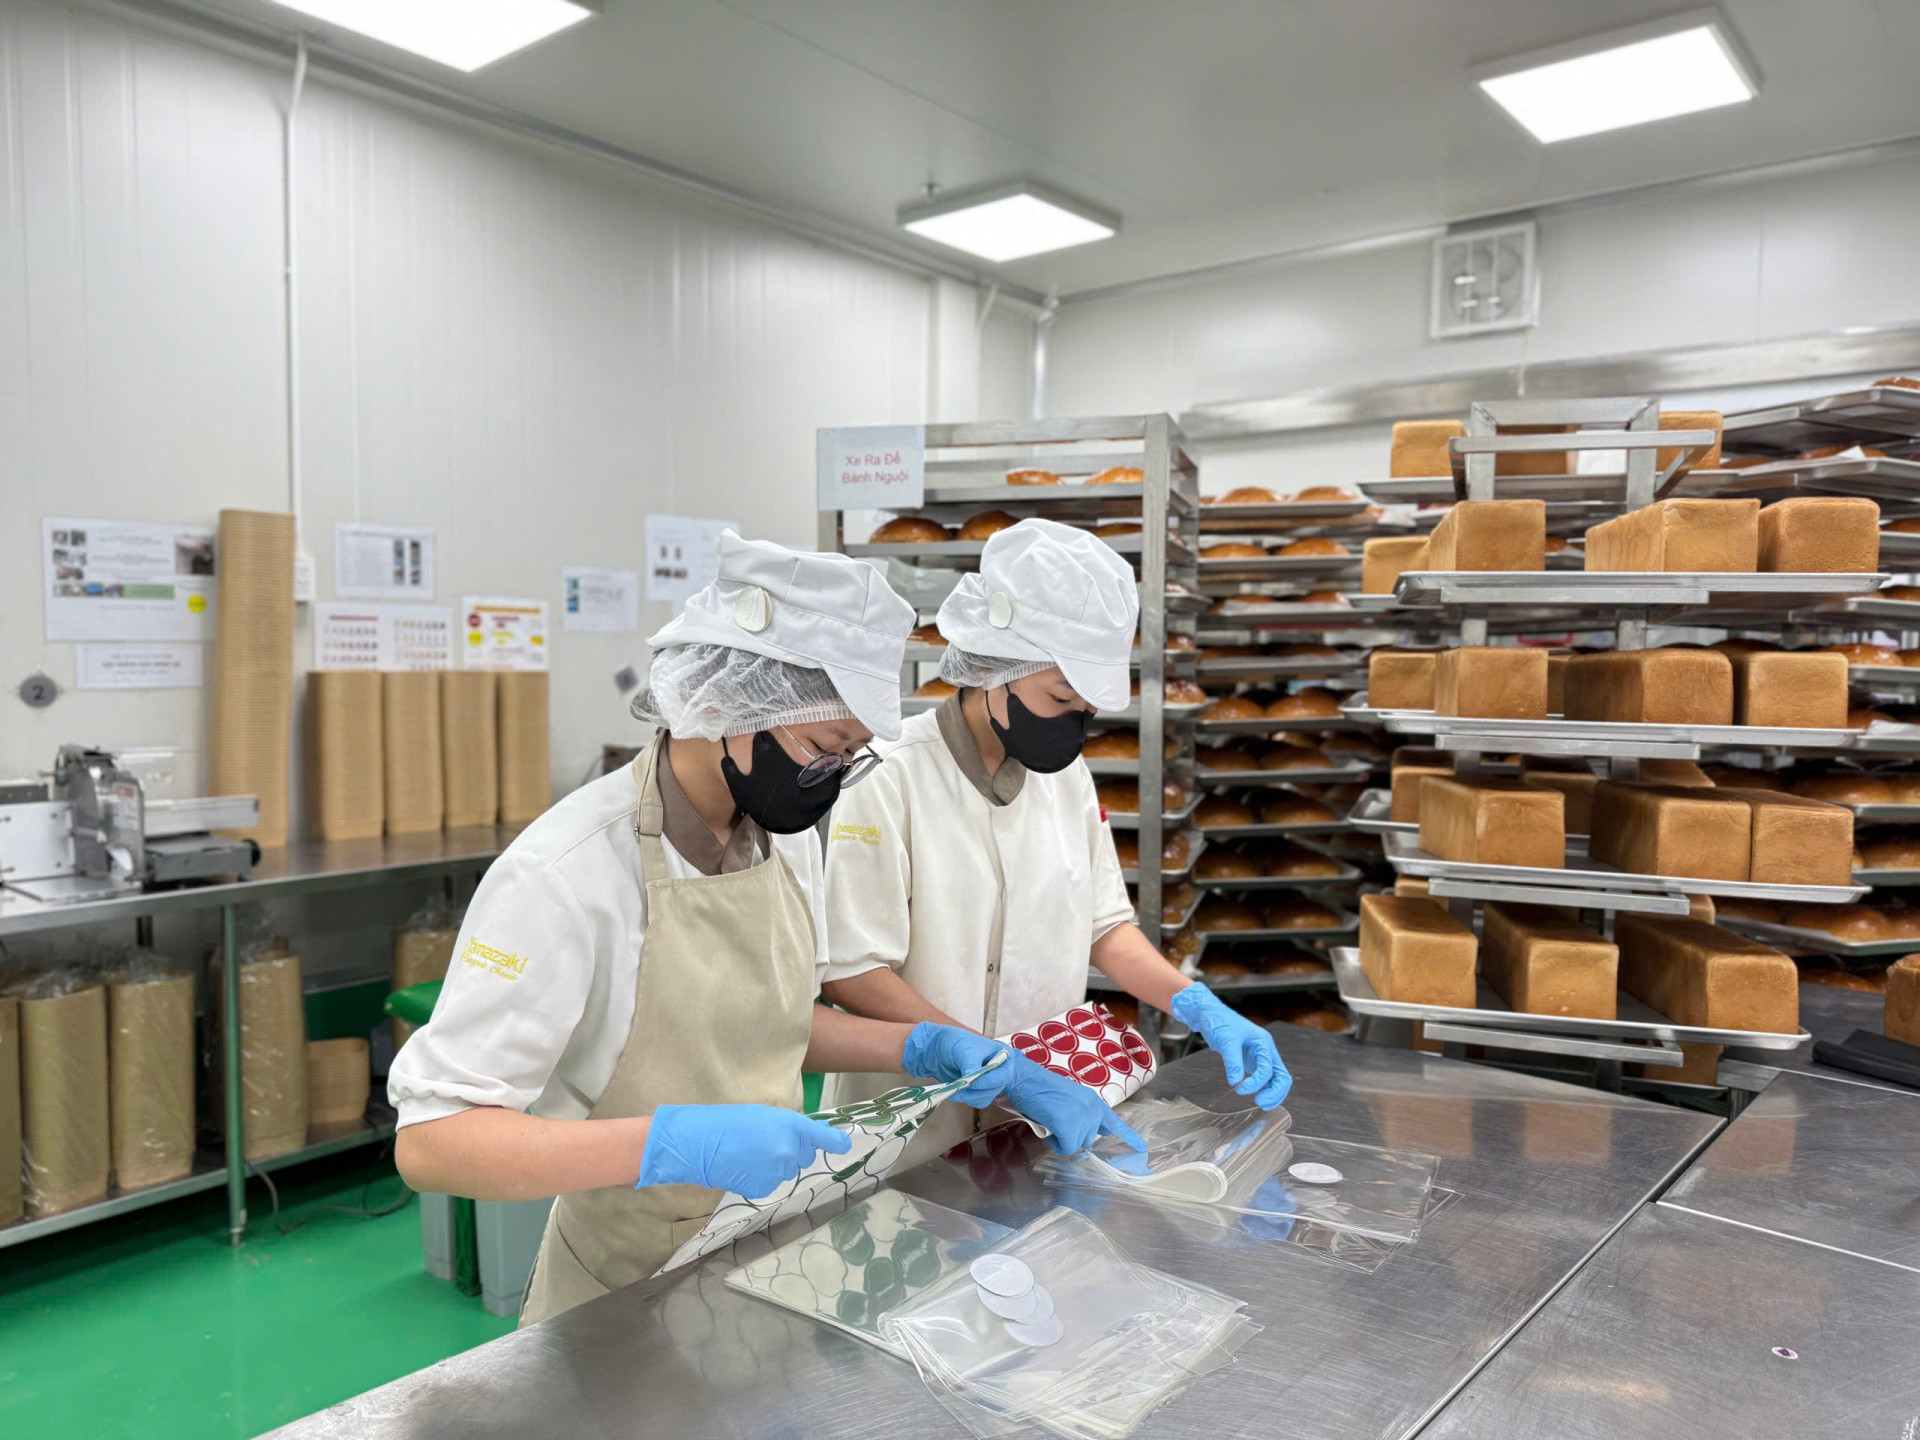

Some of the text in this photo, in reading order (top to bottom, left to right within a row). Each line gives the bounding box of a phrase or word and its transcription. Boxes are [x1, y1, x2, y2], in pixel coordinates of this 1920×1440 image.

[845, 455, 862, 467] Xe
[864, 453, 882, 466] Ra
[842, 471, 872, 484] Bánh
[32, 685, 45, 701] 2
